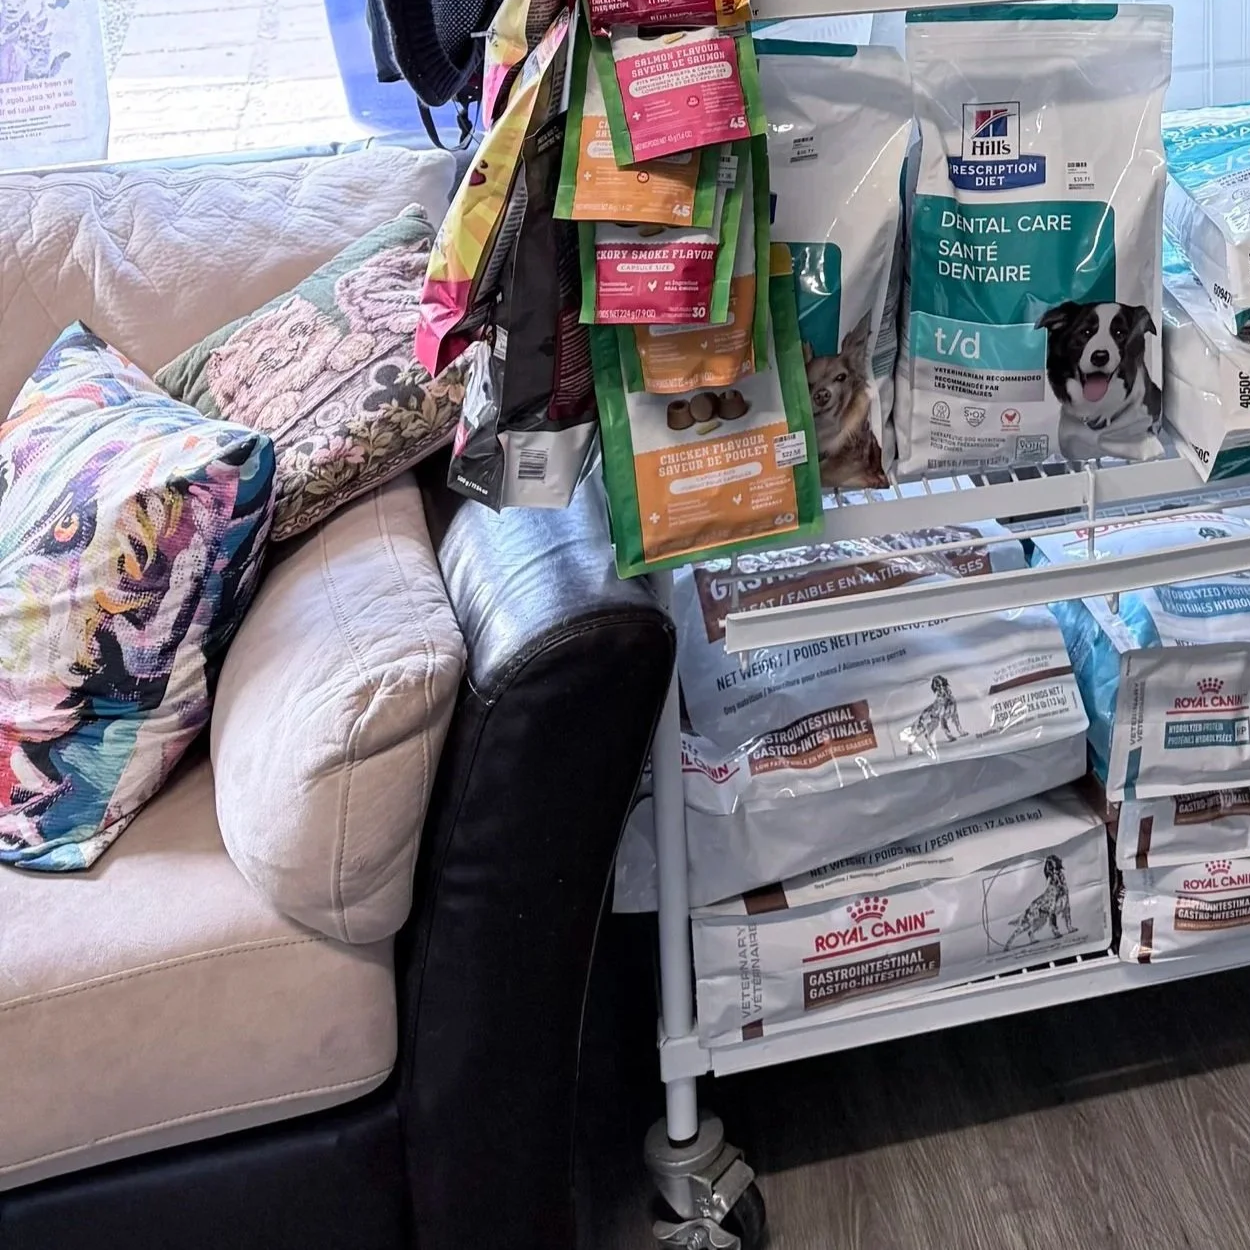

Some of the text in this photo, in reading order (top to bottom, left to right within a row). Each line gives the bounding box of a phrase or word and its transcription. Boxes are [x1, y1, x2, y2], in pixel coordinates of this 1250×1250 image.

[632, 51, 725, 78] SAVEUR DE SAUMON
[634, 44, 719, 67] SALMON FLAVOUR
[729, 116, 746, 129] 45
[972, 140, 1011, 156] Hill's
[975, 175, 1005, 186] DIET
[672, 204, 691, 217] 45
[941, 211, 1072, 233] DENTAL CARE
[938, 240, 998, 261] SANTÉ
[938, 260, 1031, 282] DENTAIRE
[692, 307, 705, 318] 30
[934, 328, 981, 359] t/d
[658, 445, 768, 478] SAVEUR DE POULET
[774, 512, 795, 526] 60
[786, 577, 857, 604] FAIBLE EN
[716, 673, 740, 692] NET
[742, 654, 785, 682] WEIGHT
[794, 643, 829, 665] POIDS
[830, 634, 852, 655] NET
[1174, 696, 1243, 709] ROYAL CANIN
[1183, 877, 1218, 890] ROYAL
[814, 912, 927, 952] ROYAL CANIN
